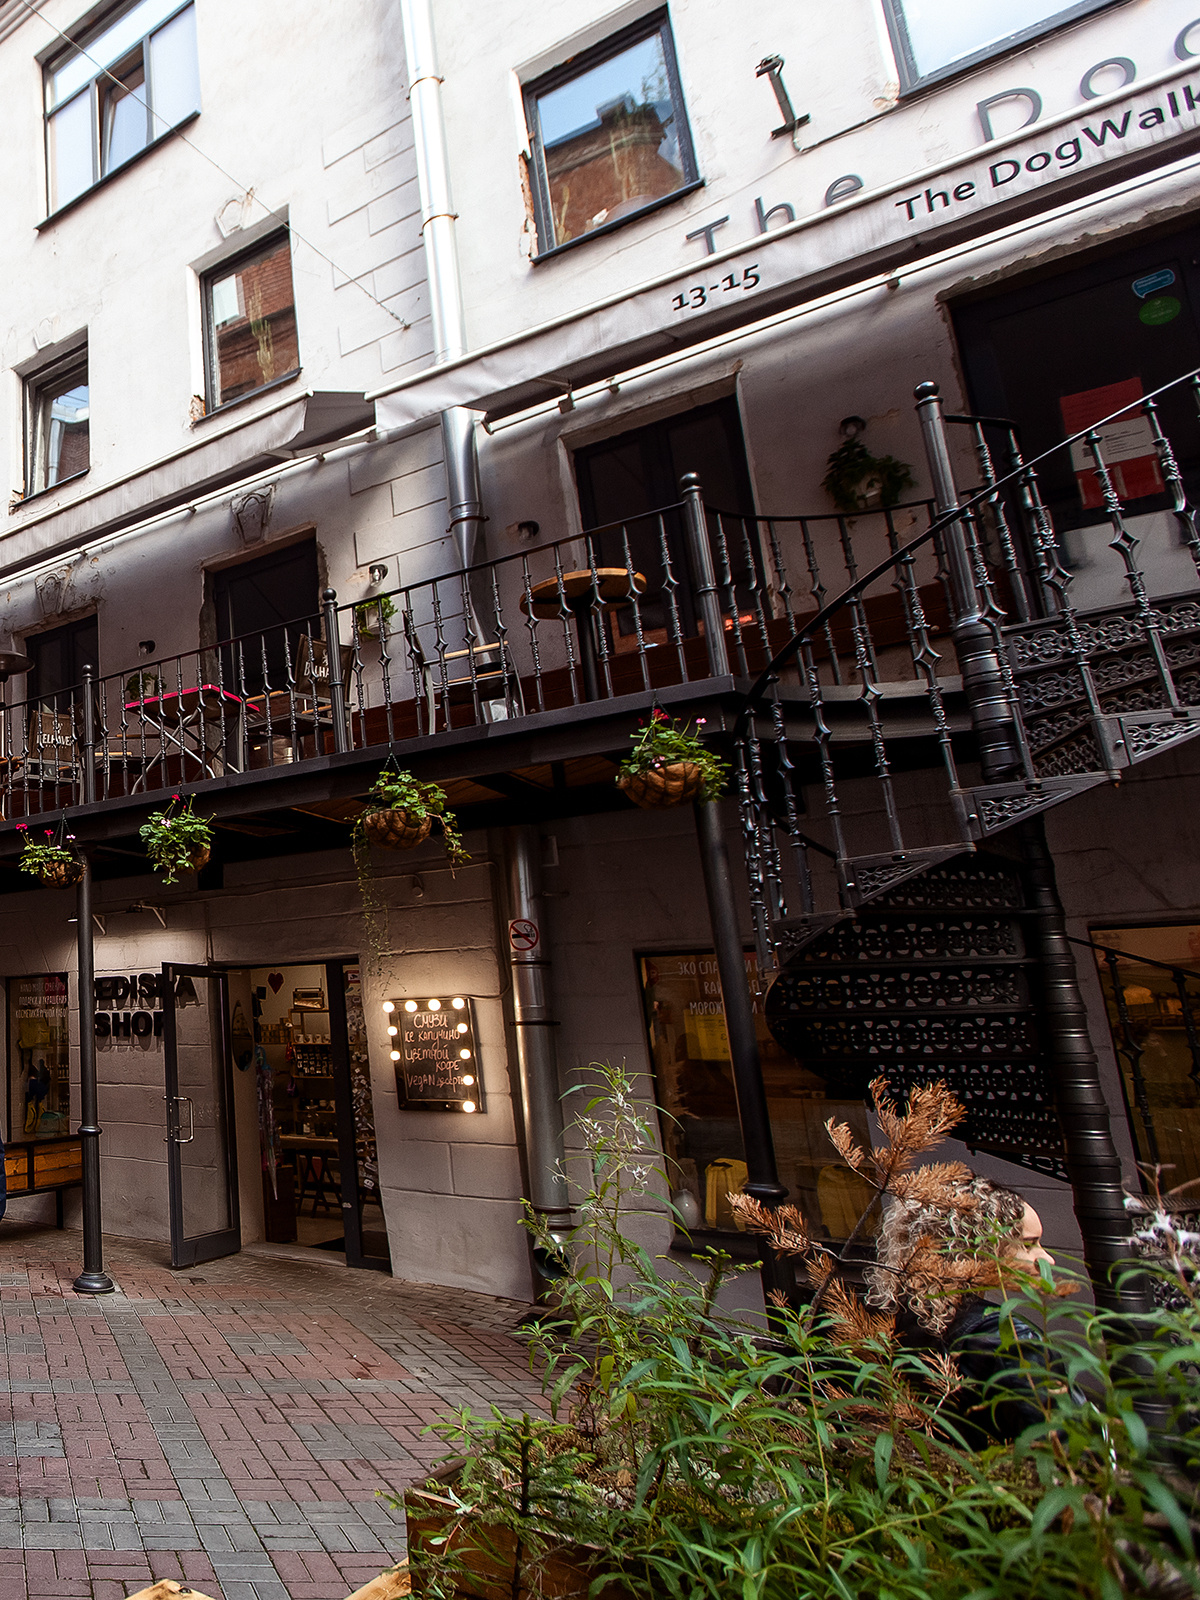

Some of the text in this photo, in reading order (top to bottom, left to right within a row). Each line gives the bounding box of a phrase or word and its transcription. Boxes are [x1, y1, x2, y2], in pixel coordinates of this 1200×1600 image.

[896, 181, 977, 221] The
[671, 263, 761, 312] 13-15
[94, 973, 198, 1001] EDISA
